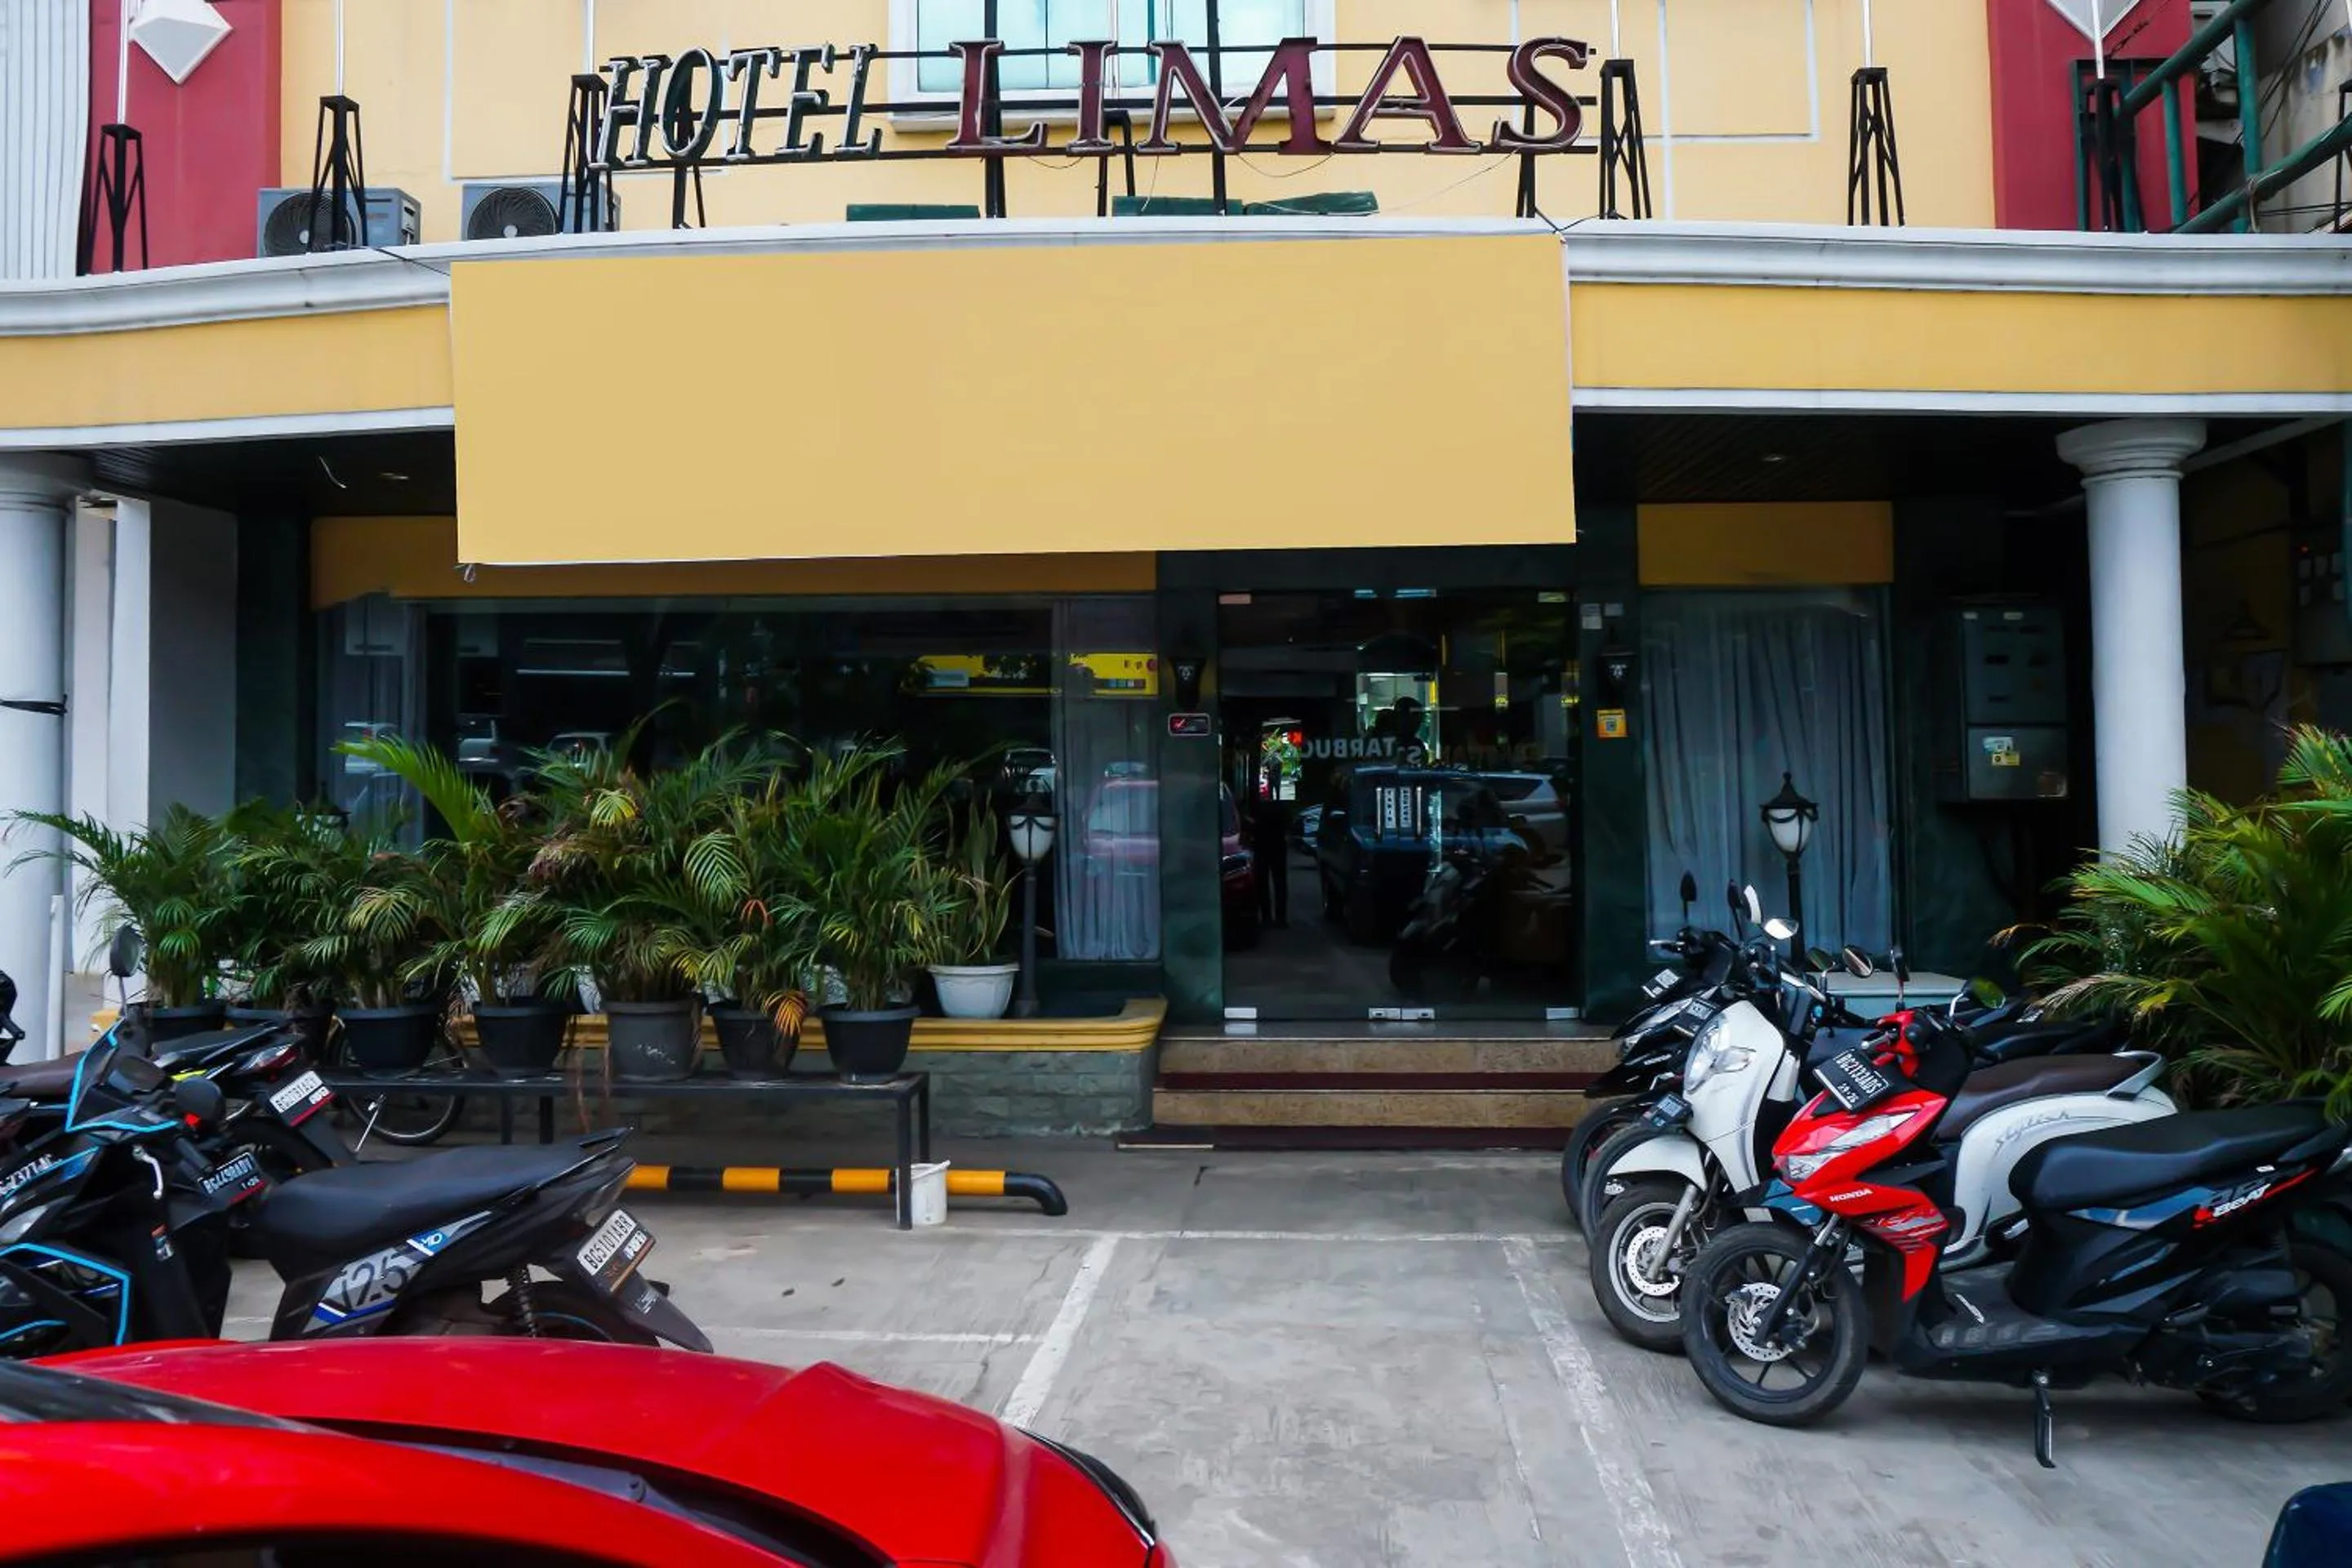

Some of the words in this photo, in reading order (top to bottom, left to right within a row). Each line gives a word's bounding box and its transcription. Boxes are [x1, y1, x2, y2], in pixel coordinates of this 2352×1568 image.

[588, 42, 883, 170] HOTEL
[946, 36, 1588, 155] LIMAS
[1829, 1187, 1874, 1202] HONDA
